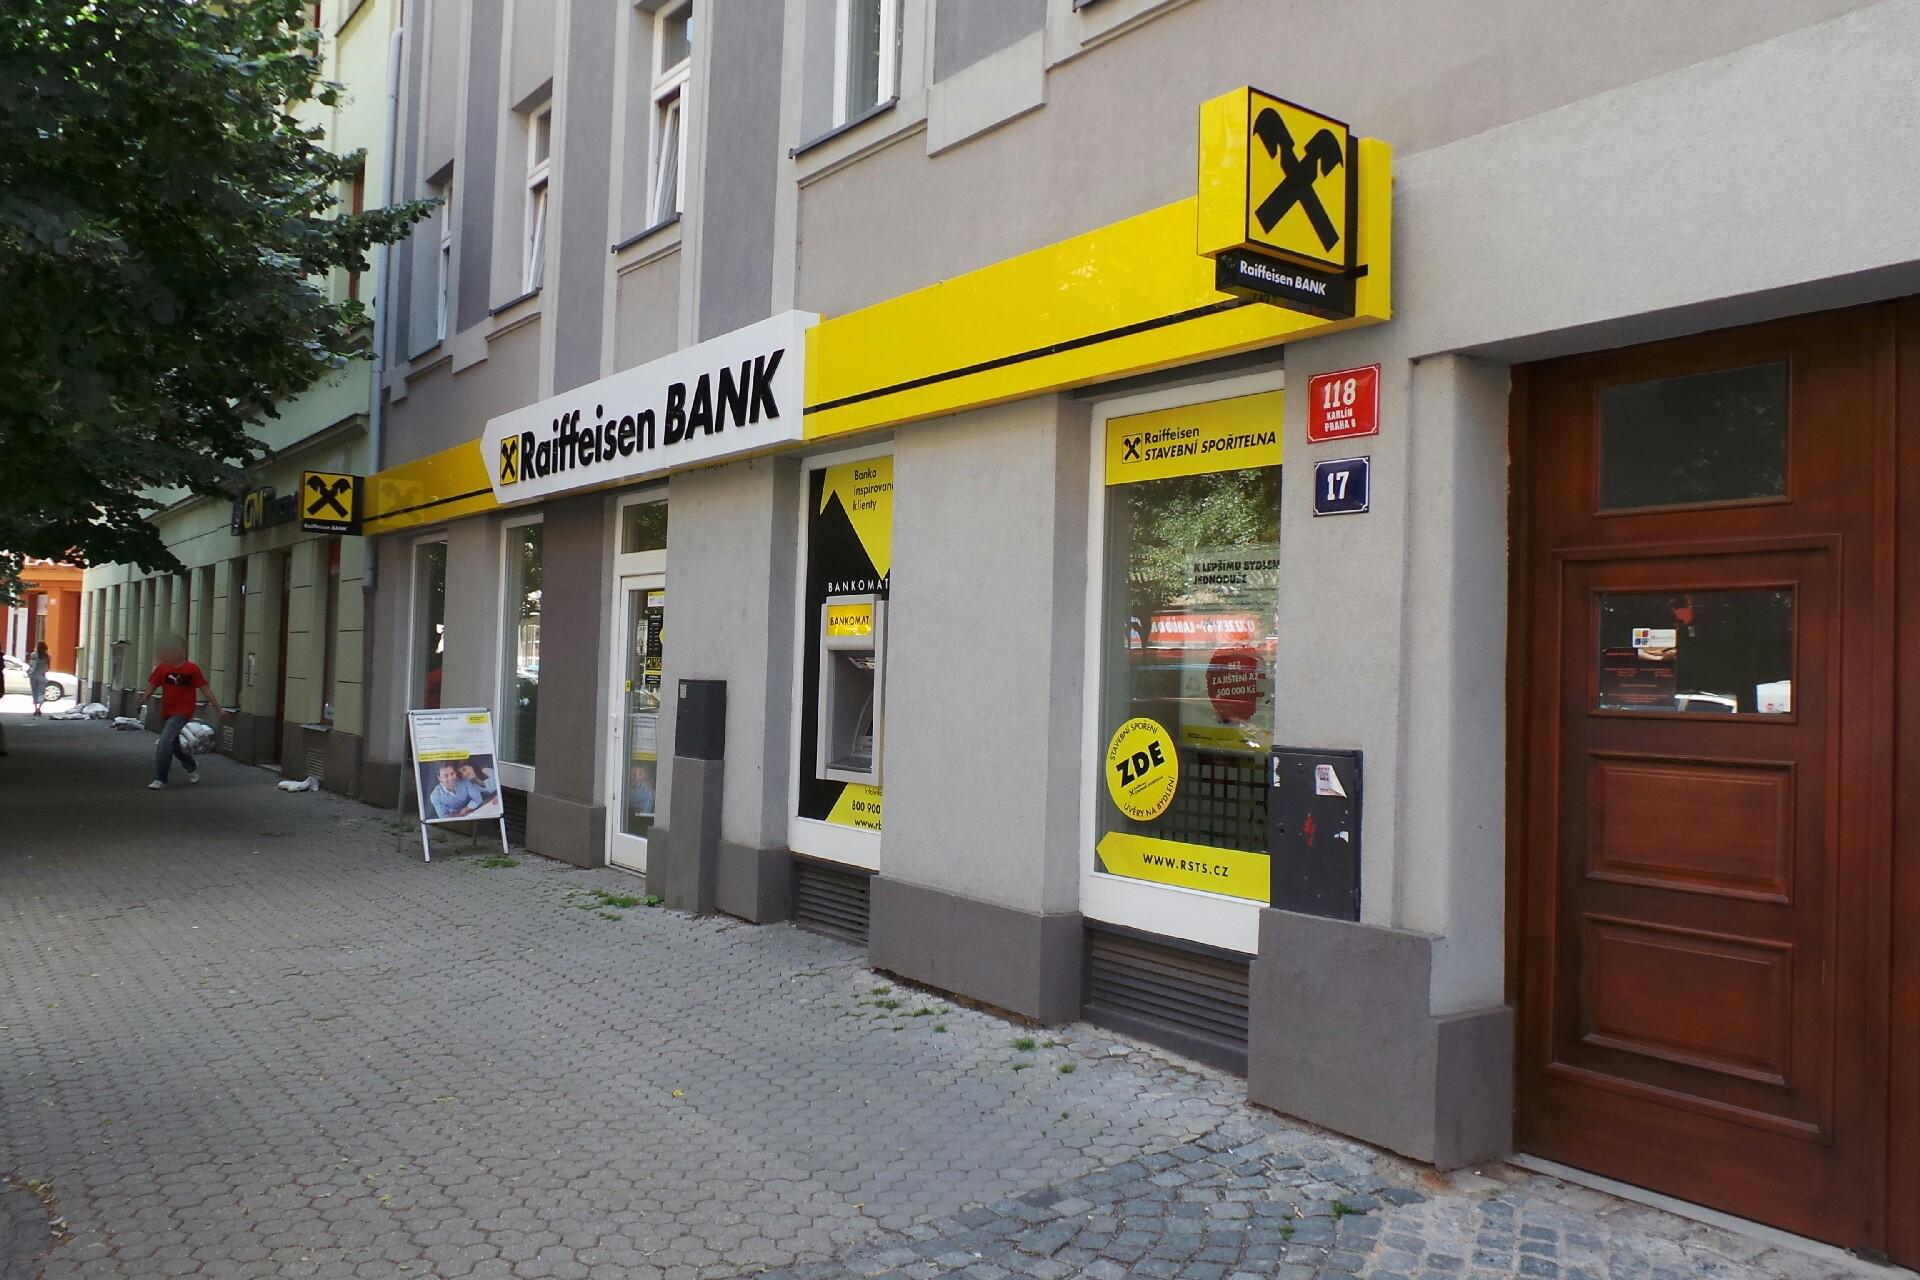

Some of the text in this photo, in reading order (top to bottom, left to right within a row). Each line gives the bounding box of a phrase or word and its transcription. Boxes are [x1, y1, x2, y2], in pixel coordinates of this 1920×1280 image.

[1240, 260, 1327, 296] Raiffeisen BANK
[1323, 378, 1356, 409] 118
[520, 348, 786, 481] Raiffeisen BANK
[1324, 419, 1350, 432] PRAHA
[1144, 427, 1200, 444] Raiffeisen
[1144, 431, 1276, 461] STAVEBNÍ SPOŘITELNA
[854, 468, 877, 480] Banka
[1326, 471, 1349, 501] 17
[852, 499, 877, 511] klienty
[828, 579, 889, 593] BANKOMAT
[830, 615, 870, 626] BANKOMAT
[1231, 686, 1246, 696] 000
[1115, 740, 1166, 788] ZDE
[867, 802, 881, 815] 900
[1145, 806, 1157, 817] NA
[1142, 853, 1229, 878] WWW.RSTS.CZ
